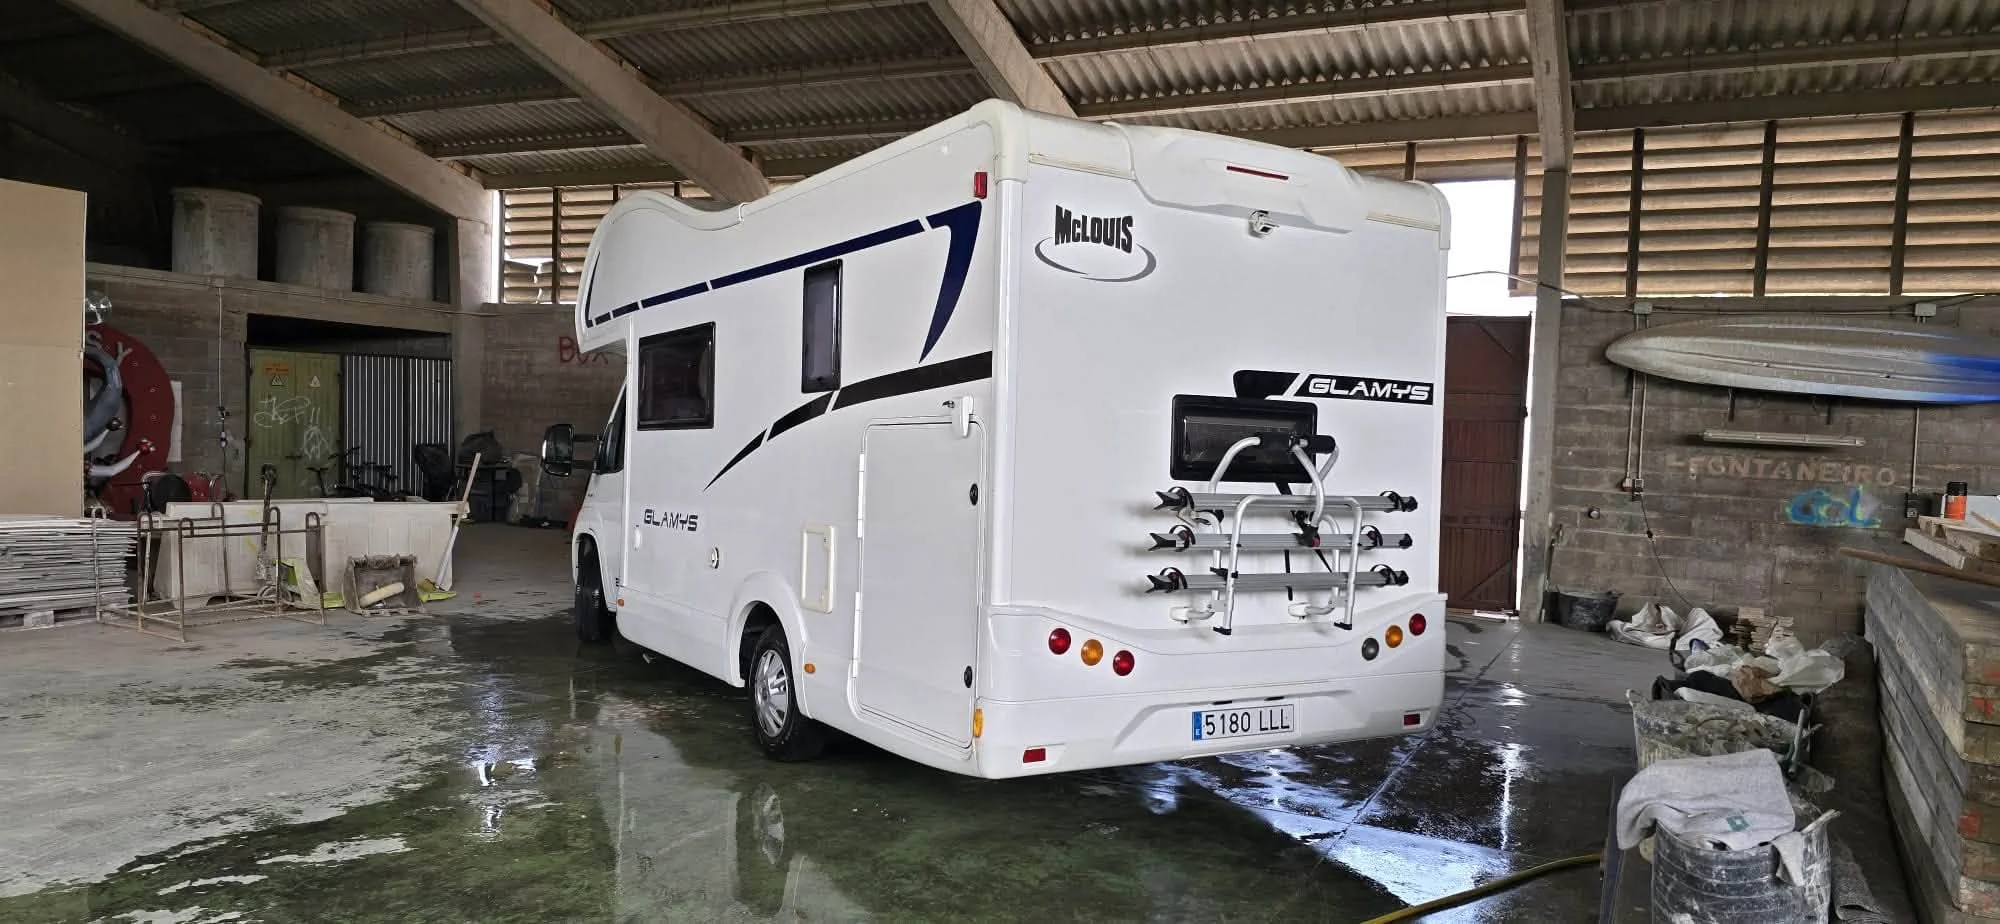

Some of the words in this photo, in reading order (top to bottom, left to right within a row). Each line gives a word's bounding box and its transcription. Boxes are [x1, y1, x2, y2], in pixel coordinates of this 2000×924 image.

[1054, 204, 1133, 254] McLOUIS
[1308, 378, 1431, 401] GLAMYS
[643, 508, 699, 532] GLAMYS
[1205, 711, 1251, 736] 5180
[1259, 708, 1290, 731] LLL
